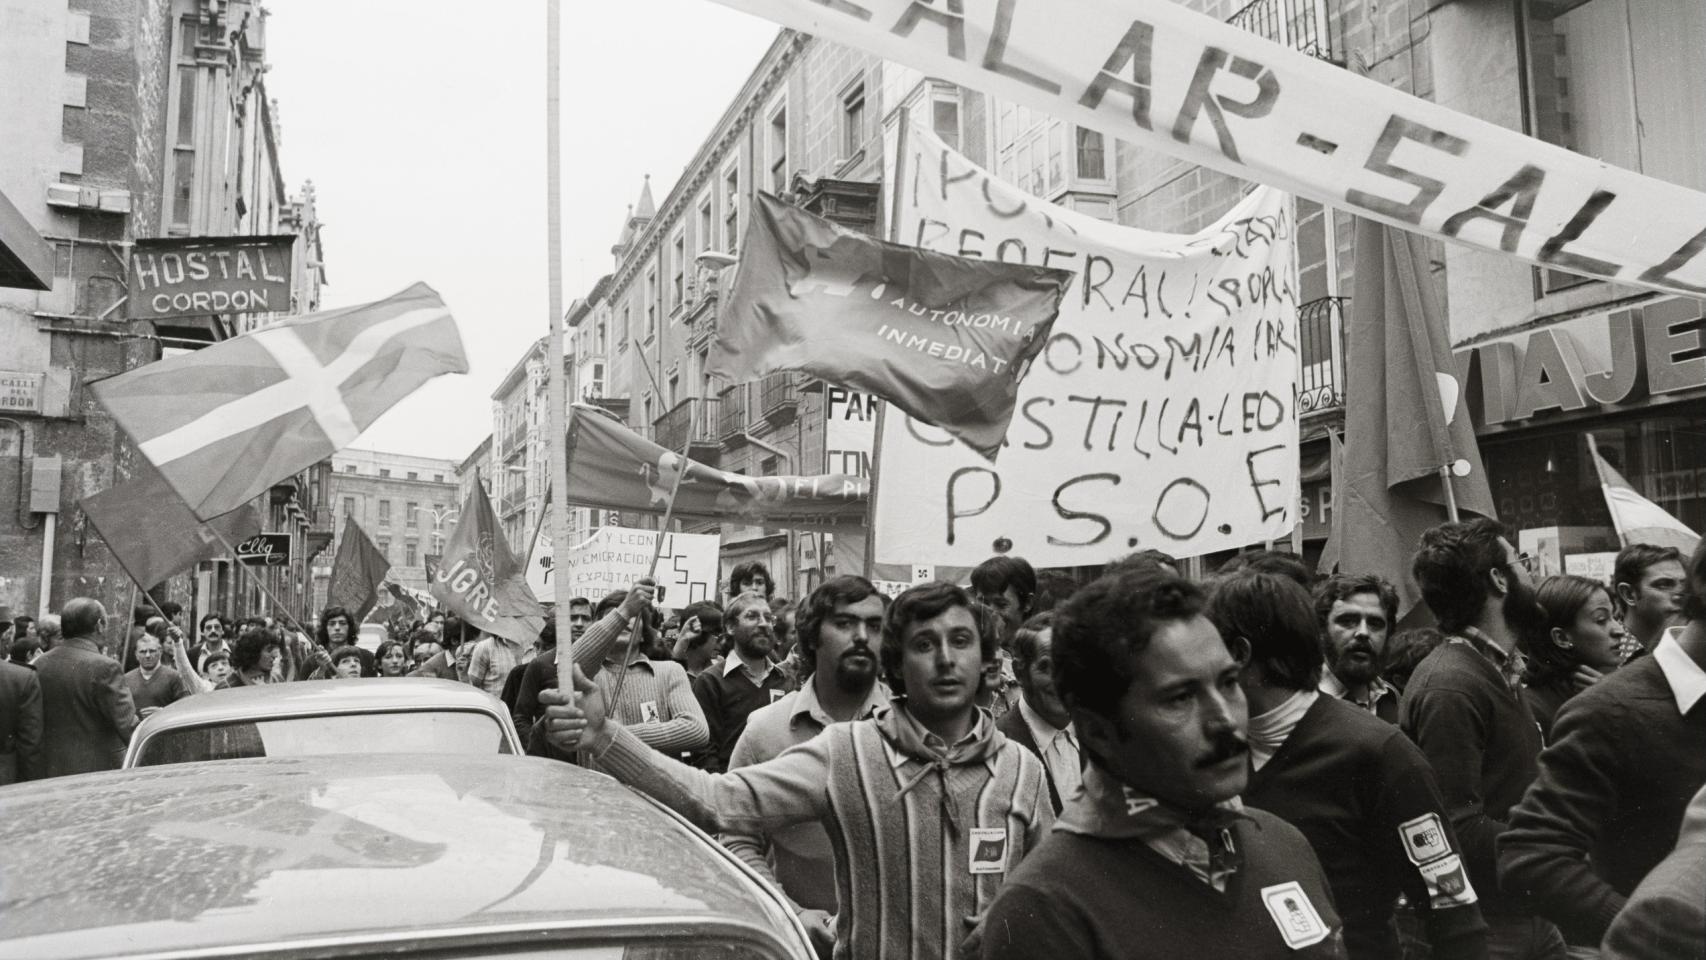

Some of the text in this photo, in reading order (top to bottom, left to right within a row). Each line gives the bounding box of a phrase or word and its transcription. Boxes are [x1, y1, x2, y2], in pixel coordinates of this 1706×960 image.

[133, 249, 285, 291] HOSTAL
[152, 288, 268, 313] CORDON
[890, 297, 1036, 342] AUTONOMIA
[436, 559, 501, 623] JGRE
